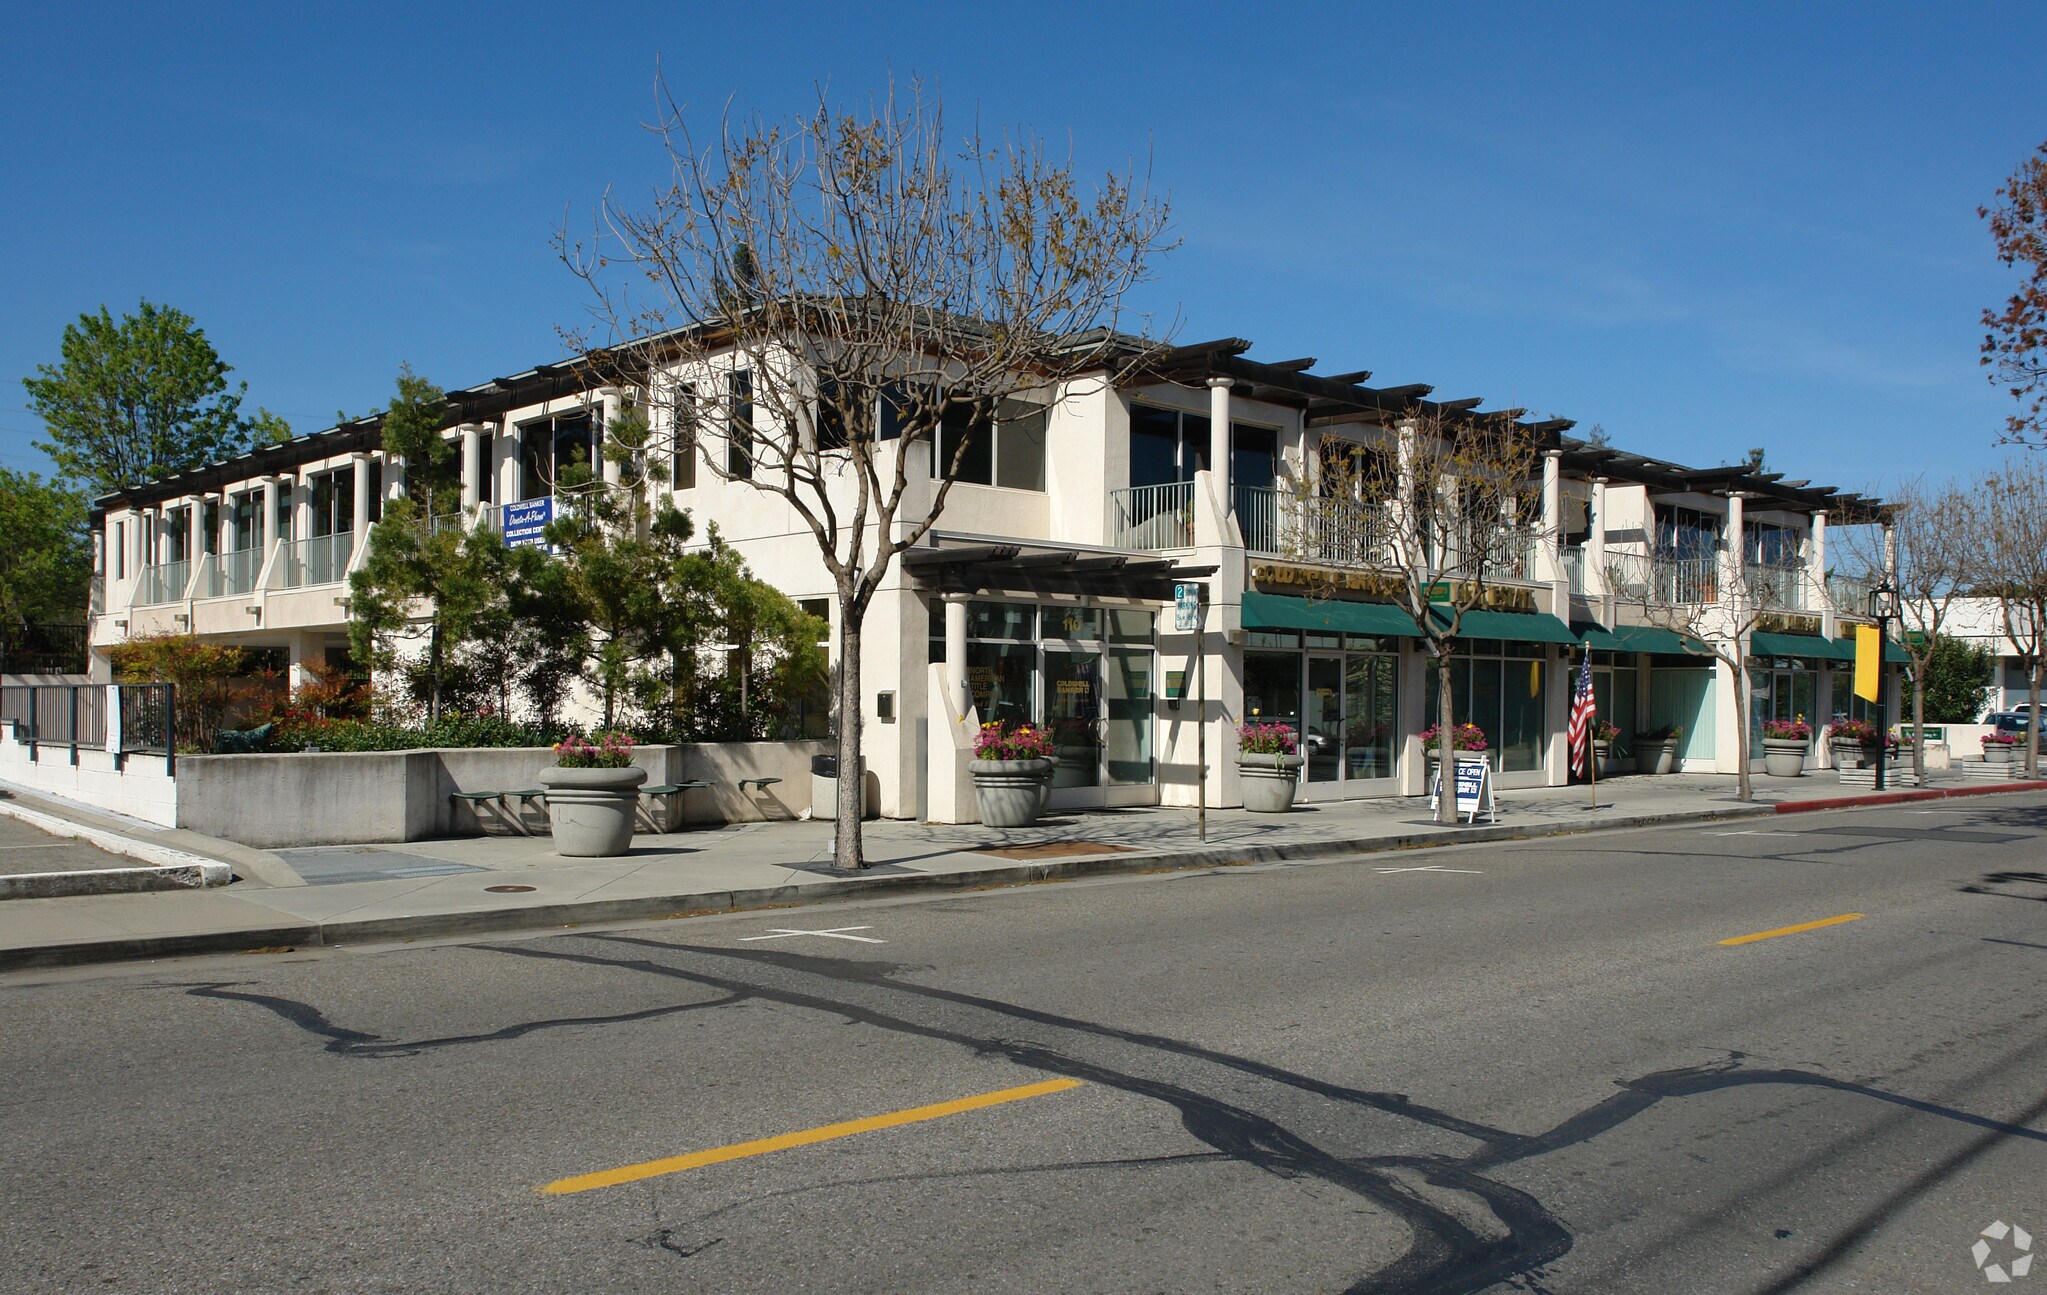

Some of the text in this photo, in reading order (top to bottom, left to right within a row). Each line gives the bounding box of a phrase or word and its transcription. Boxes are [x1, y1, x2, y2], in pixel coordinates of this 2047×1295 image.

[510, 500, 544, 511] COLDWELL BANKER
[506, 527, 533, 538] COLLECTION
[1486, 584, 1536, 609] ESTATE
[1063, 618, 1081, 631] 110
[1467, 768, 1481, 776] OPEN
